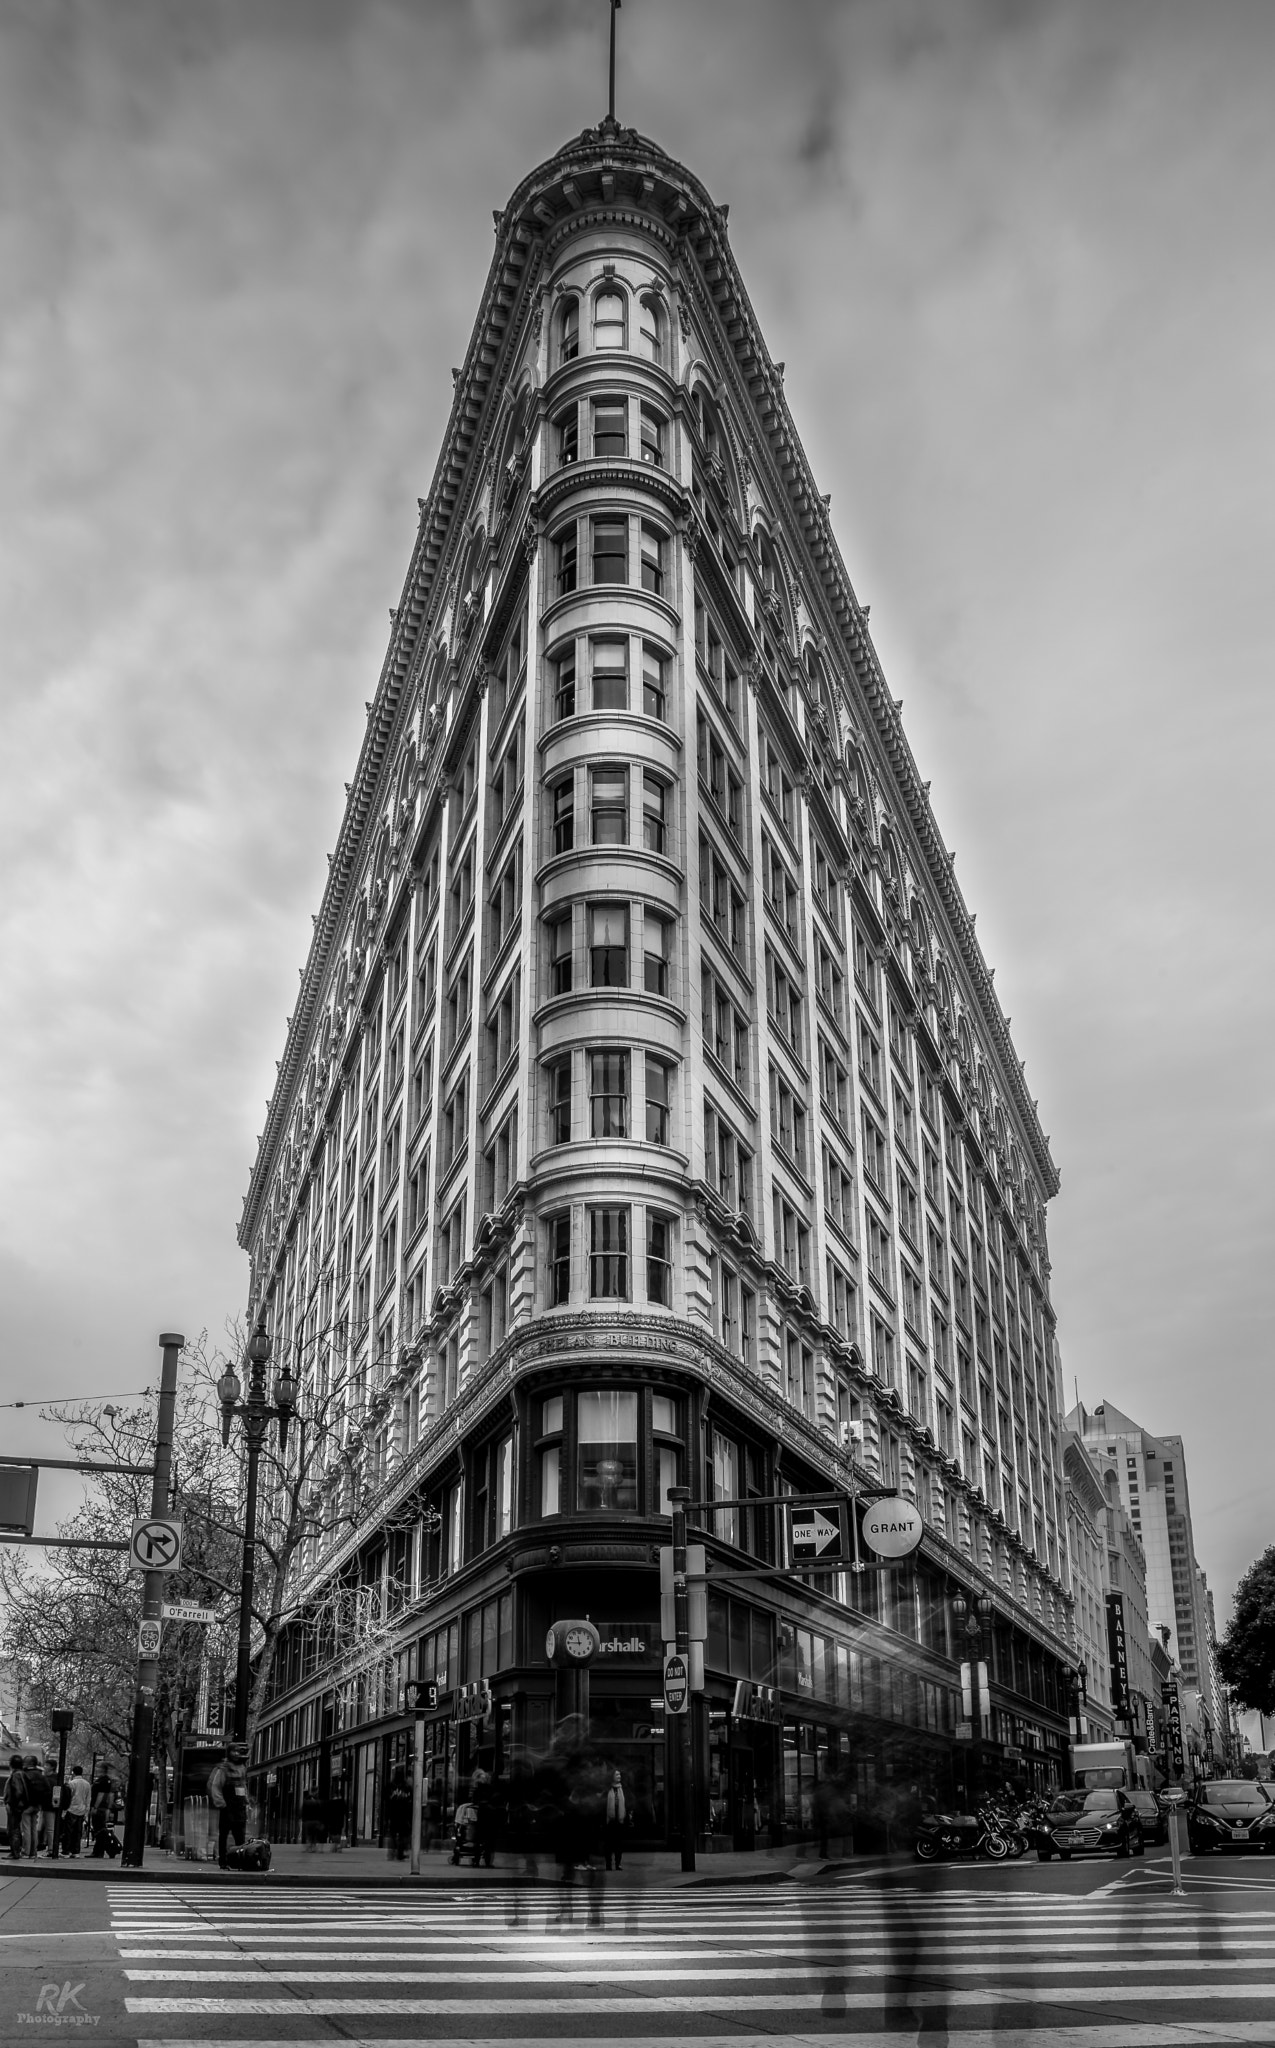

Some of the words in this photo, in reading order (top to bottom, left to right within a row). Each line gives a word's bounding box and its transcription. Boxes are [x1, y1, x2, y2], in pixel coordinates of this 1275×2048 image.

[538, 1334, 594, 1353] PHELAN
[609, 1333, 677, 1349] BUILDING
[794, 1529, 812, 1539] ONE
[817, 1528, 835, 1537] WAY
[870, 1521, 915, 1534] GRANT
[169, 1607, 208, 1620] O'Farrell
[144, 1640, 156, 1649] 50
[598, 1637, 646, 1653] rshalls
[1114, 1603, 1128, 1710] BARNEY
[667, 1667, 674, 1678] DO
[674, 1666, 684, 1677] NOT
[429, 1686, 437, 1706] 9
[668, 1691, 683, 1702] ENTER
[1145, 1701, 1157, 1755] Crate&Barrel
[1169, 1696, 1183, 1765] PARKING
